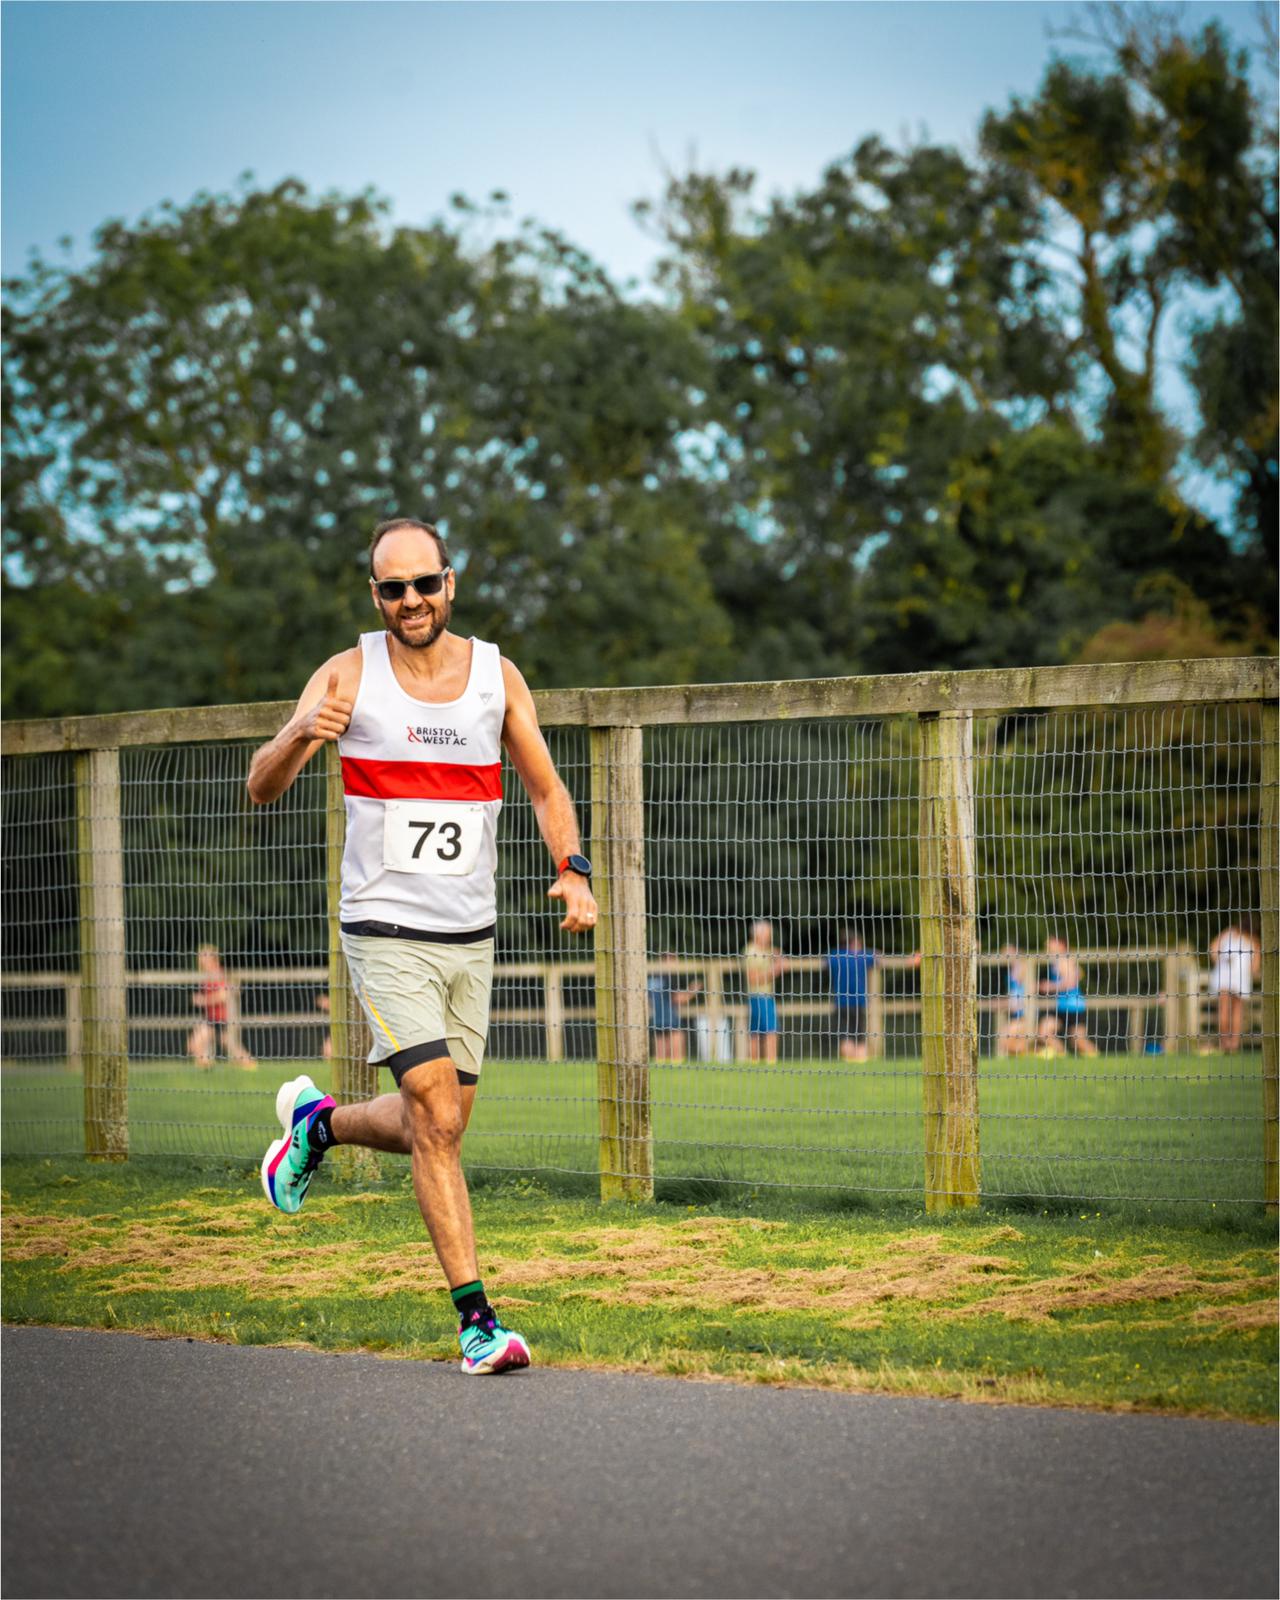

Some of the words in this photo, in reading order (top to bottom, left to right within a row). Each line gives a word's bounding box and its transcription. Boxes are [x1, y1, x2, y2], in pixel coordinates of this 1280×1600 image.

[416, 726, 458, 737] BRISTOL
[422, 735, 450, 745] WEST
[452, 737, 468, 746] AC
[408, 820, 462, 861] 73
